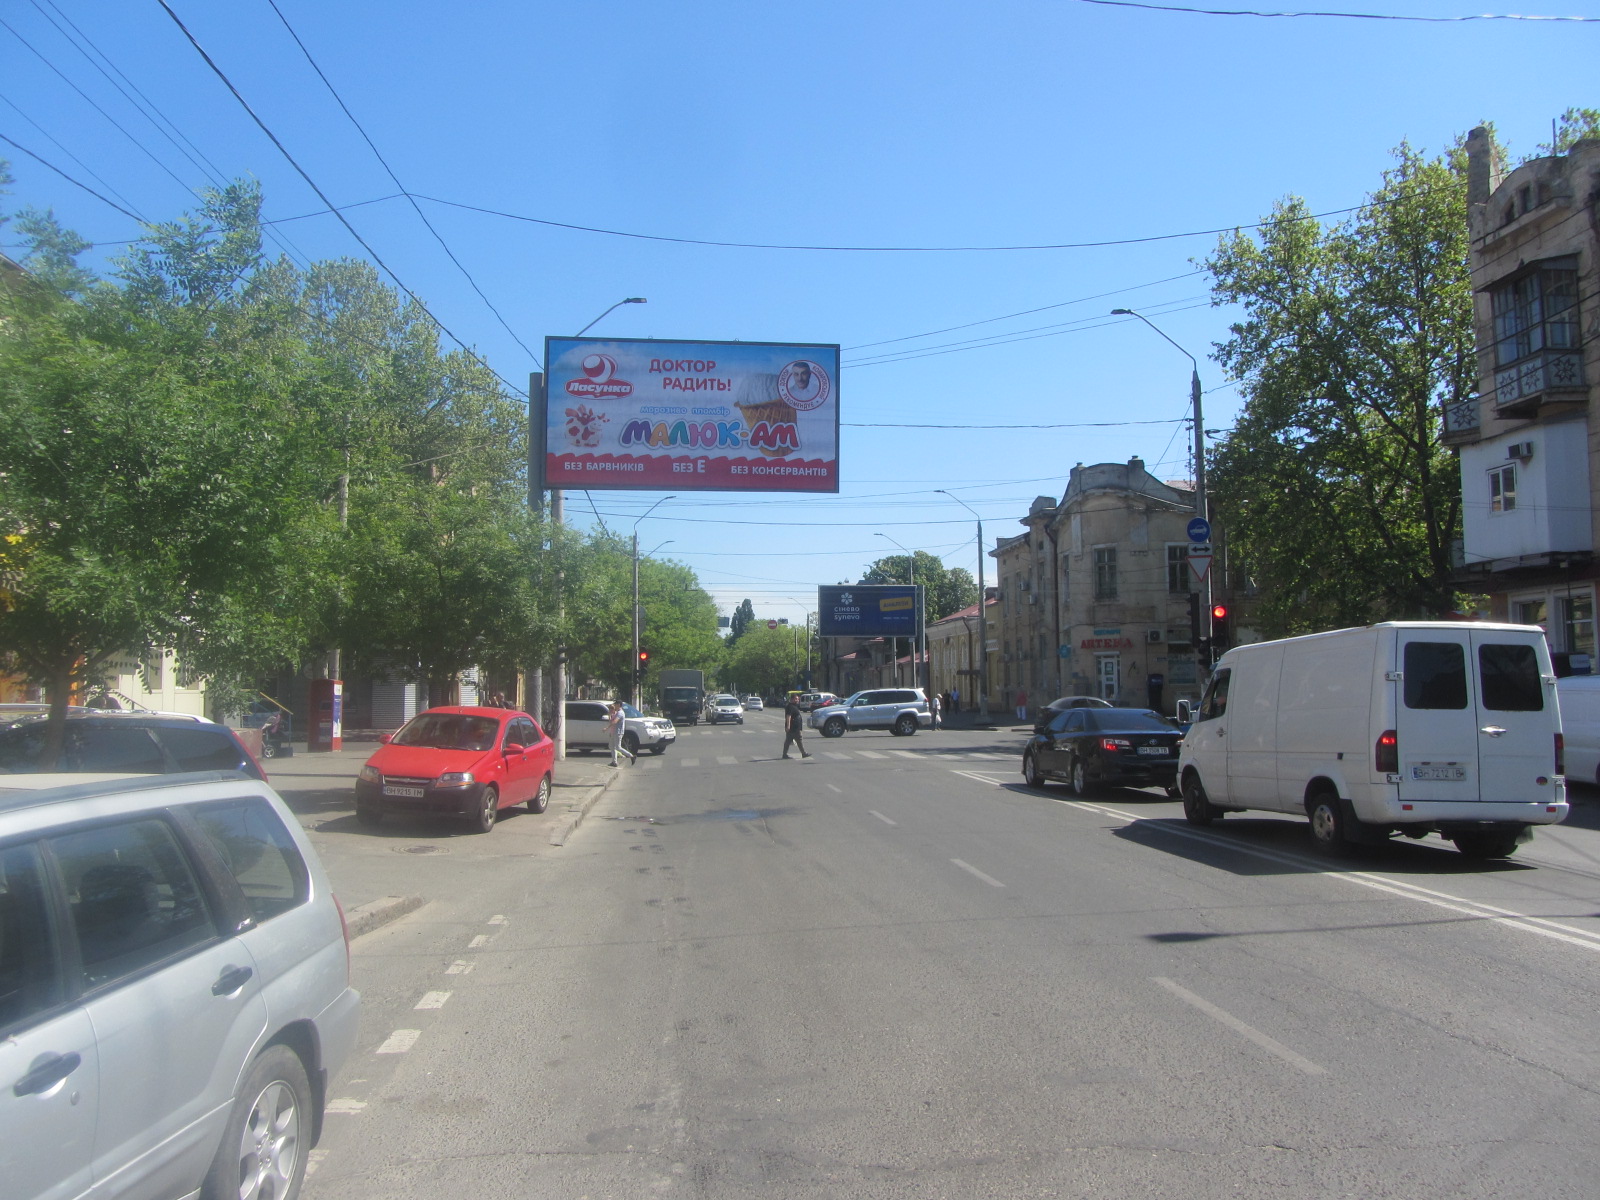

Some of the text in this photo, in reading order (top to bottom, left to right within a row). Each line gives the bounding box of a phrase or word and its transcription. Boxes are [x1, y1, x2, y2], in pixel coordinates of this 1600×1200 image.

[649, 359, 717, 374] ДОКТОР
[568, 382, 631, 395] Ласунка
[663, 377, 732, 392] РАДИТЬ!
[692, 406, 731, 417] пломбір
[564, 461, 645, 472] БЕЗ БАРВНИКІВ
[672, 462, 694, 473] БЕЗ
[731, 465, 828, 477] БЕЗ КОНСЕРВАНТІВ
